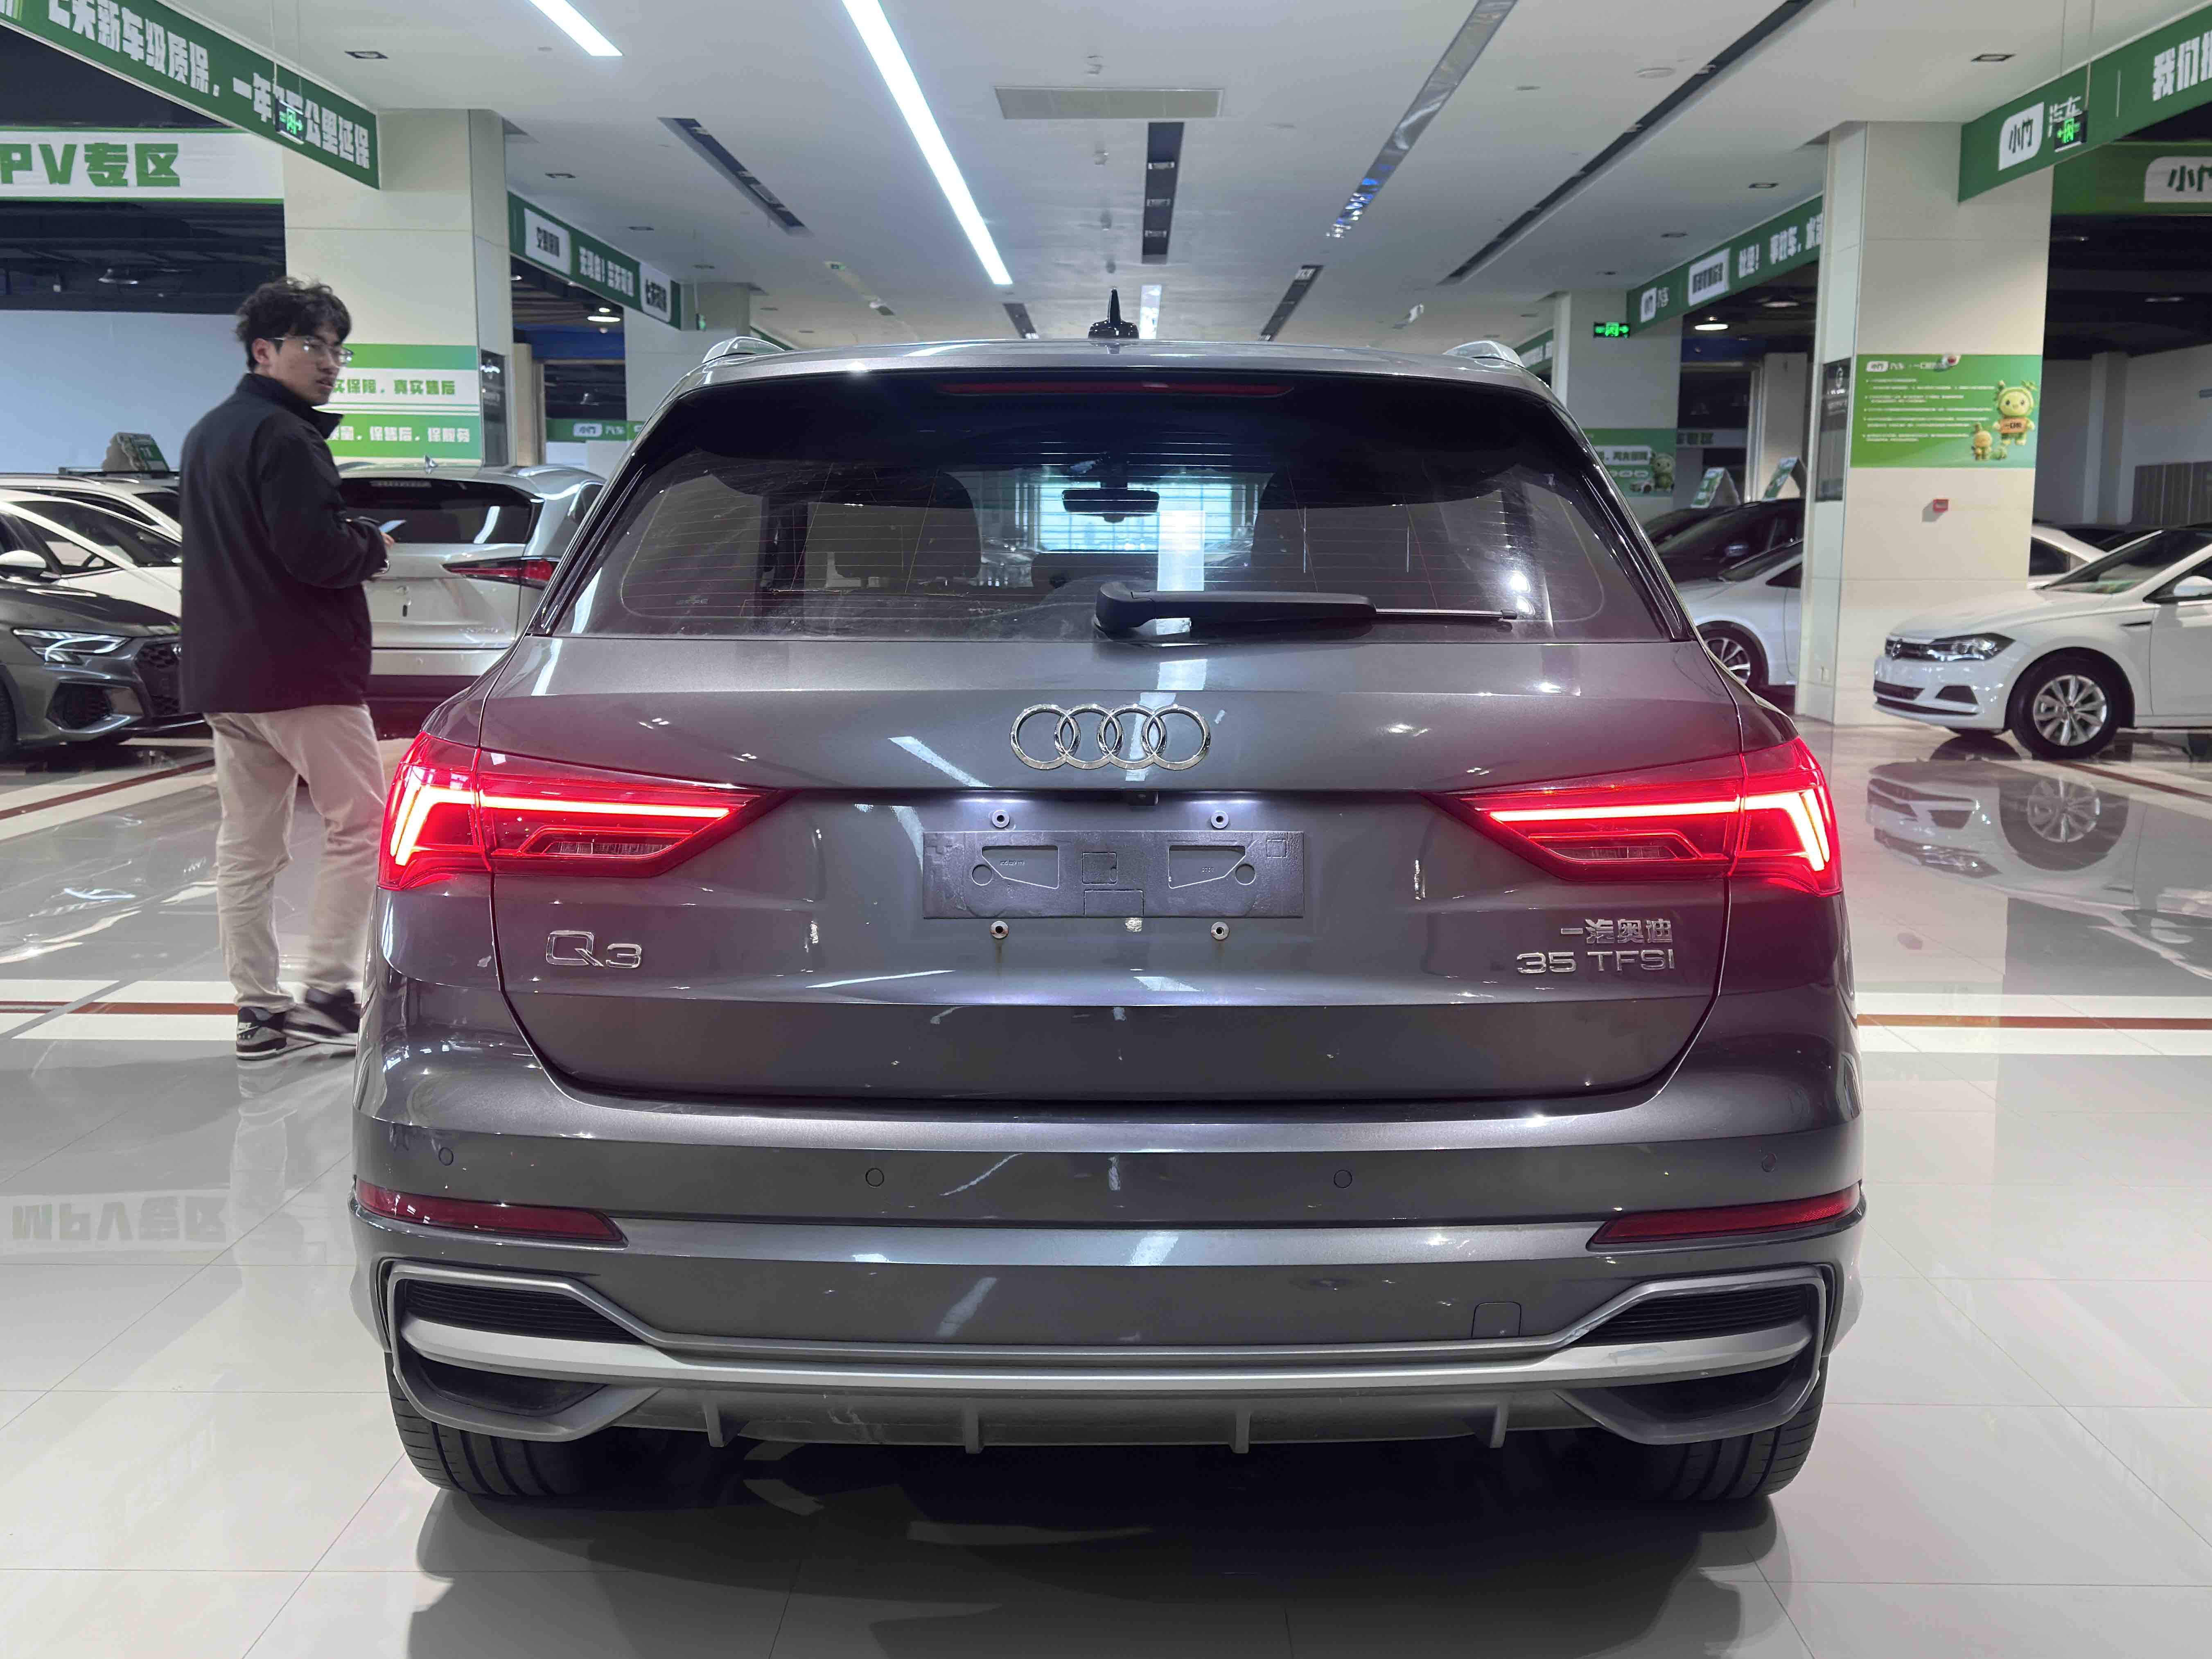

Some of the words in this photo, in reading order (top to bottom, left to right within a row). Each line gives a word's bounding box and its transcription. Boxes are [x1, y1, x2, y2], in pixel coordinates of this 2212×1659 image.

[1561, 918, 1673, 943] 一汽奥迪
[546, 930, 642, 968] Q3
[1517, 952, 1576, 974] 35
[1587, 949, 1675, 972] TFSI
